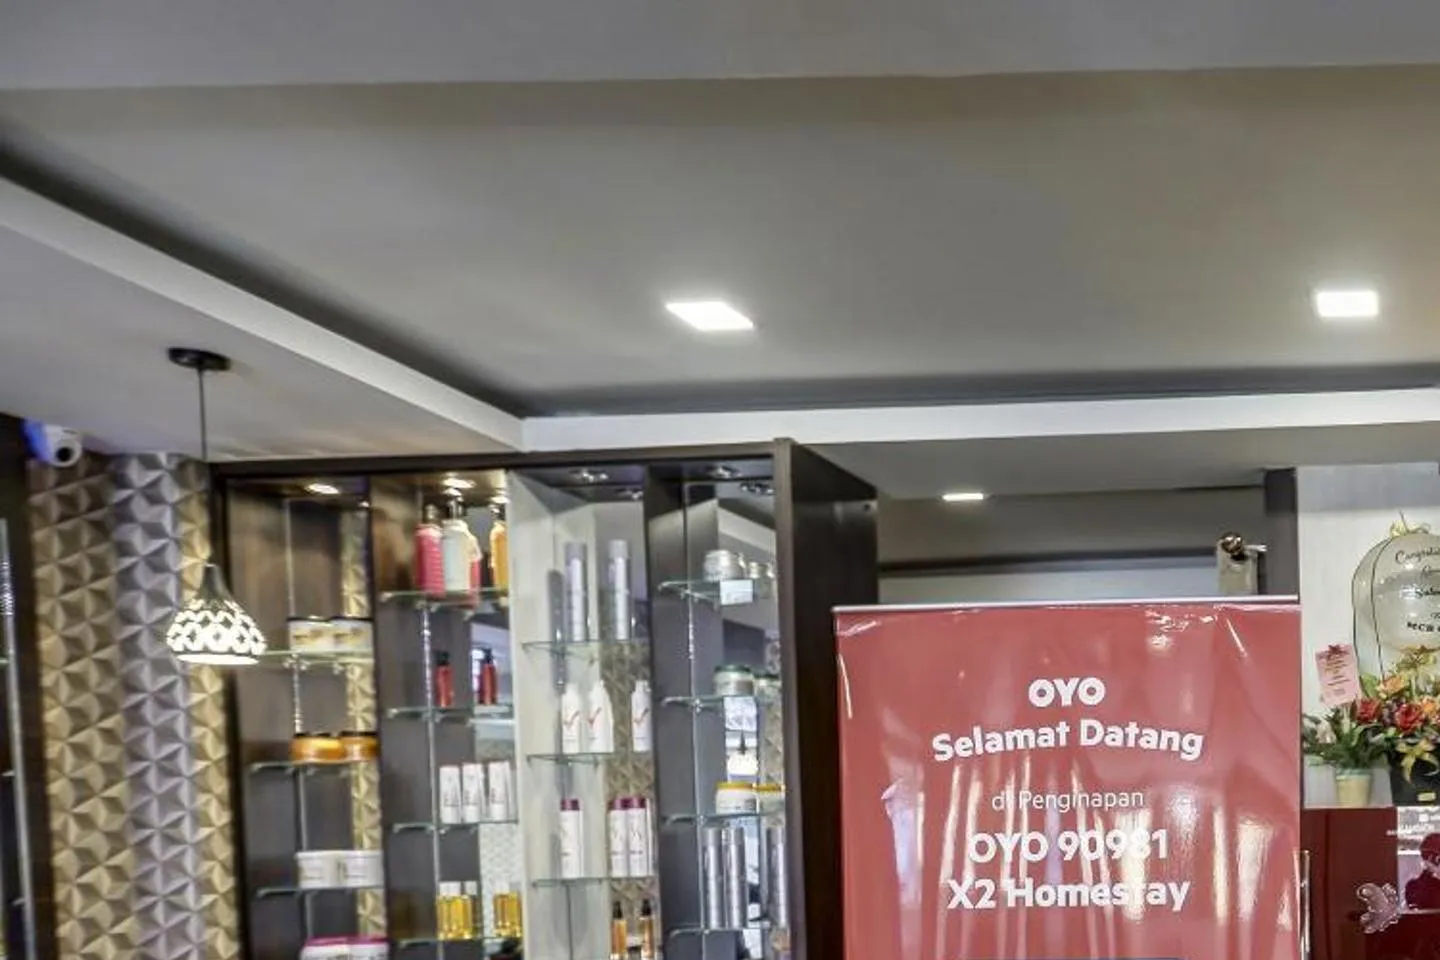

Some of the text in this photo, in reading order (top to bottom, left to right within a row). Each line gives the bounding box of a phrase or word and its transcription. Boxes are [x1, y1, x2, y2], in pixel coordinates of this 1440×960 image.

[1028, 676, 1106, 708] OYO
[932, 718, 1204, 762] Selamat Datang
[992, 789, 1144, 813] di Penginapan
[967, 829, 1168, 863] OYO 90981
[947, 879, 1190, 912] X2 Homestay
